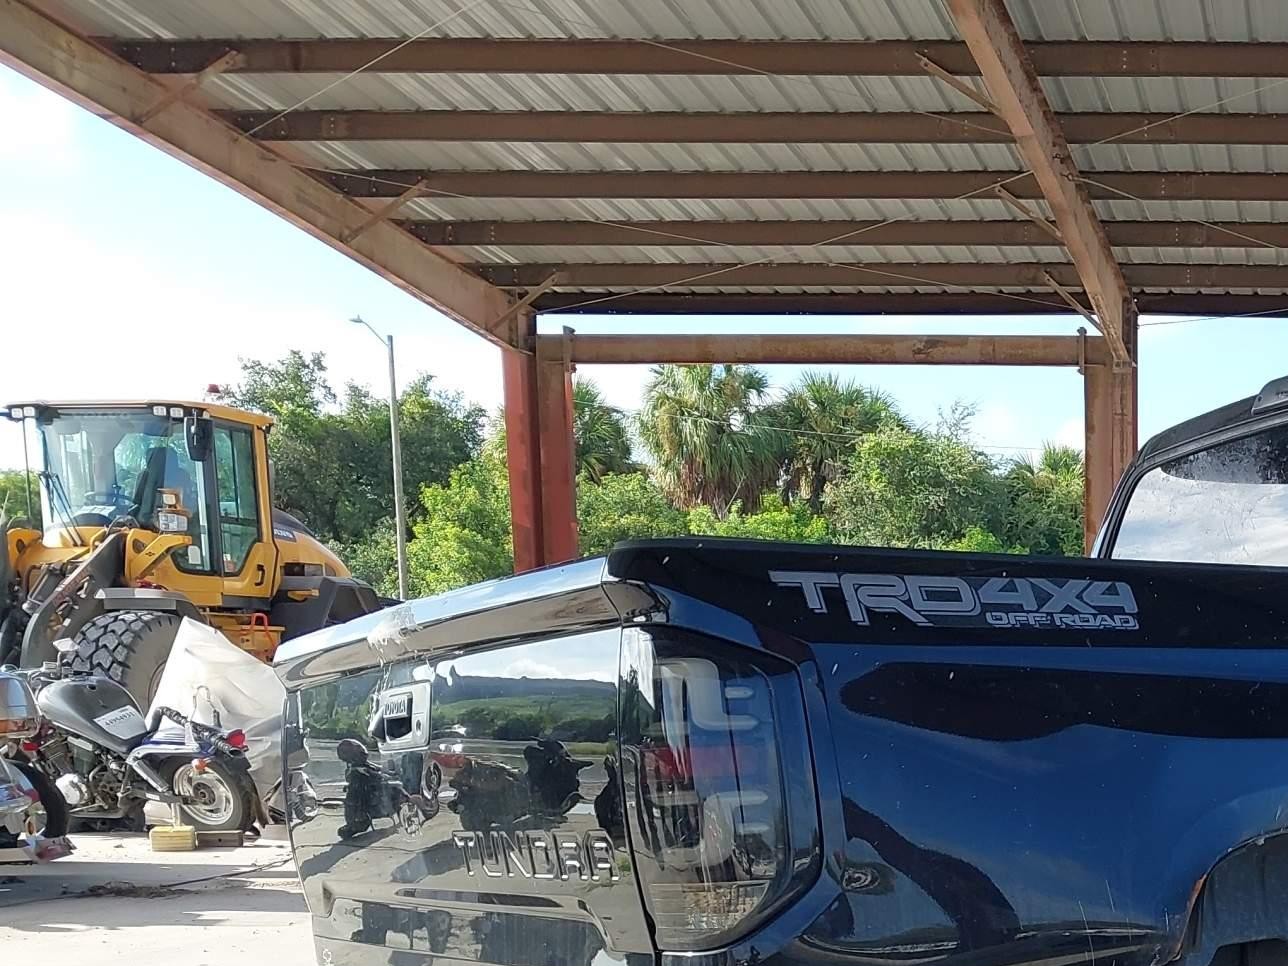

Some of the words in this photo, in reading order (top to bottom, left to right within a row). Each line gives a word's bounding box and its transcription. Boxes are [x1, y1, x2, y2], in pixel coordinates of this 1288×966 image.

[985, 611, 1049, 628] OFF
[1054, 613, 1140, 630] ROAD
[451, 829, 622, 881] TUNDRA
